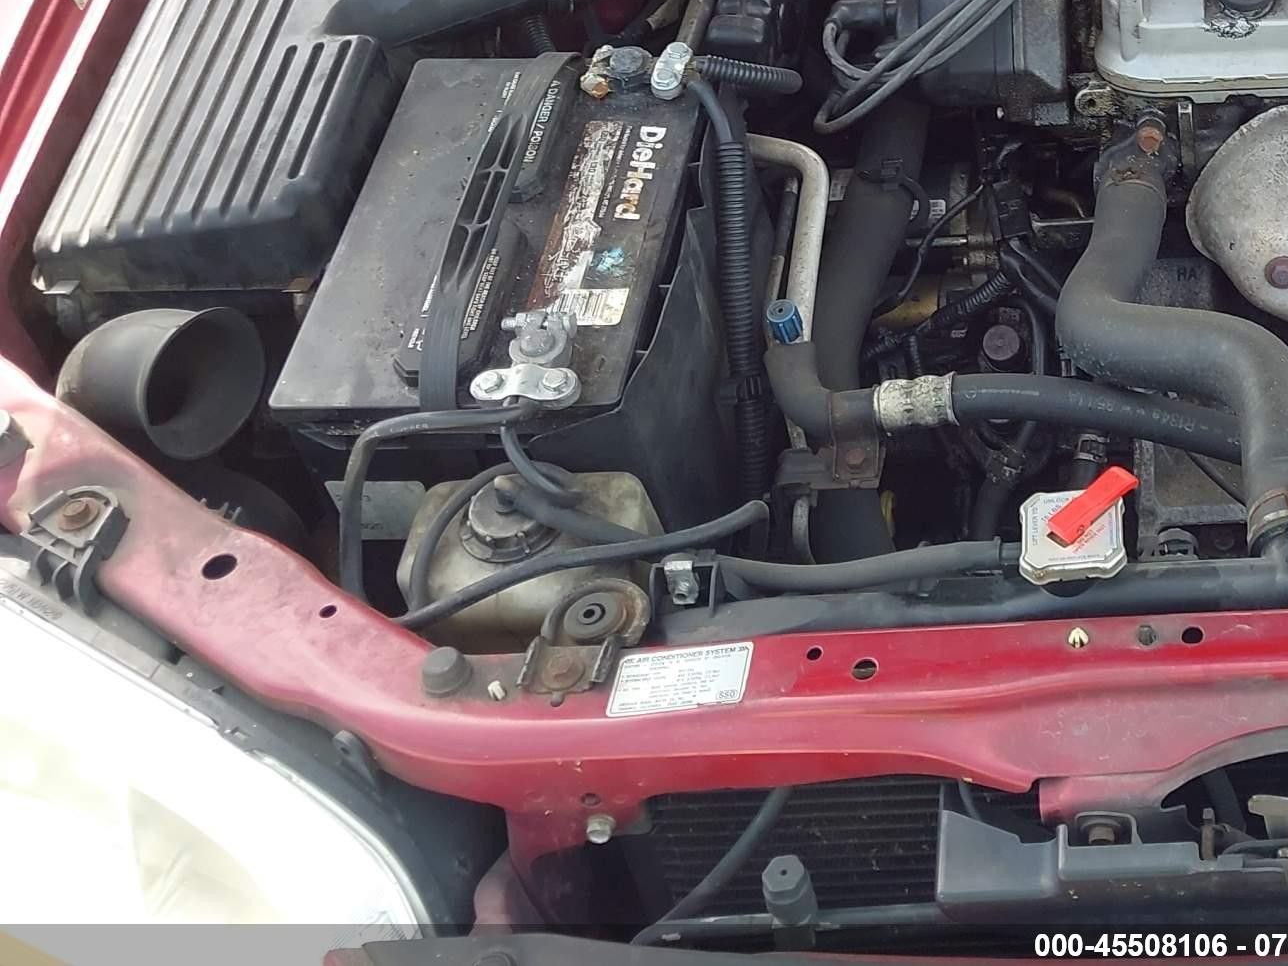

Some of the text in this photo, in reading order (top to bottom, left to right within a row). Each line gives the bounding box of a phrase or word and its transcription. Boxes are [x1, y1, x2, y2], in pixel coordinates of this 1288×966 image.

[537, 87, 559, 123] DANGER
[522, 130, 544, 164] POISON
[613, 125, 667, 221] DieHard
[651, 650, 704, 663] CONDITIONER
[705, 646, 738, 656] SYSTEM
